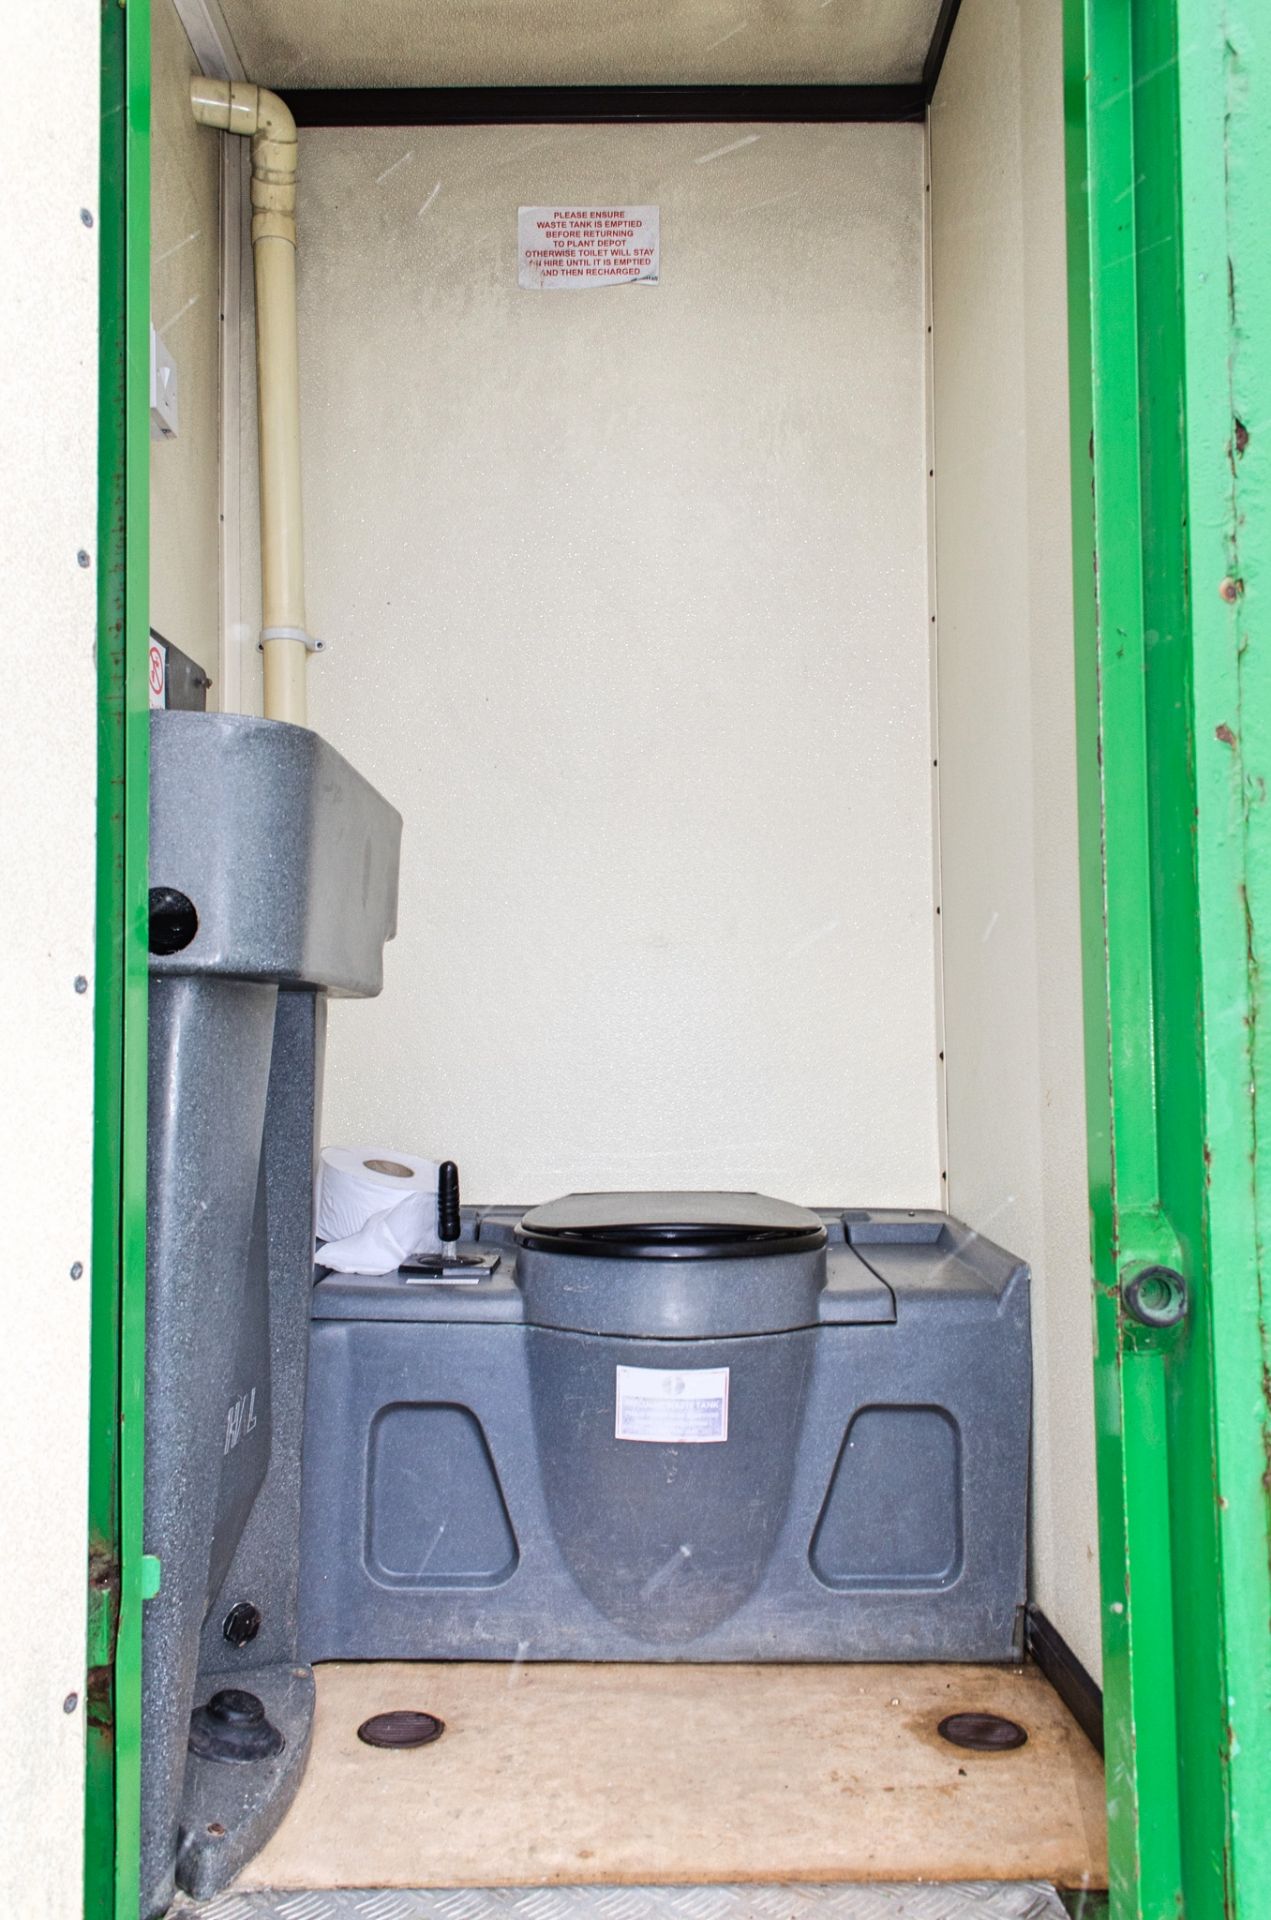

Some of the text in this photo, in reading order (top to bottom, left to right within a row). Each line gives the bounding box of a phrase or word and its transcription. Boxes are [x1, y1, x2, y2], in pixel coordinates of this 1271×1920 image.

[554, 211, 625, 219] PLEASE ENSURE
[537, 221, 567, 229] WASTE
[605, 220, 642, 228] EMPTIED
[546, 230, 634, 238] BEFORE RETURNING
[553, 239, 627, 248] TO PLANT DEPOT
[525, 250, 576, 258] OTHERWISE
[579, 249, 608, 257] TOILET
[633, 248, 655, 256] STAY
[566, 259, 591, 267] UNTIL
[614, 258, 651, 266] EMPTIED
[586, 268, 641, 276] RECHARGED
